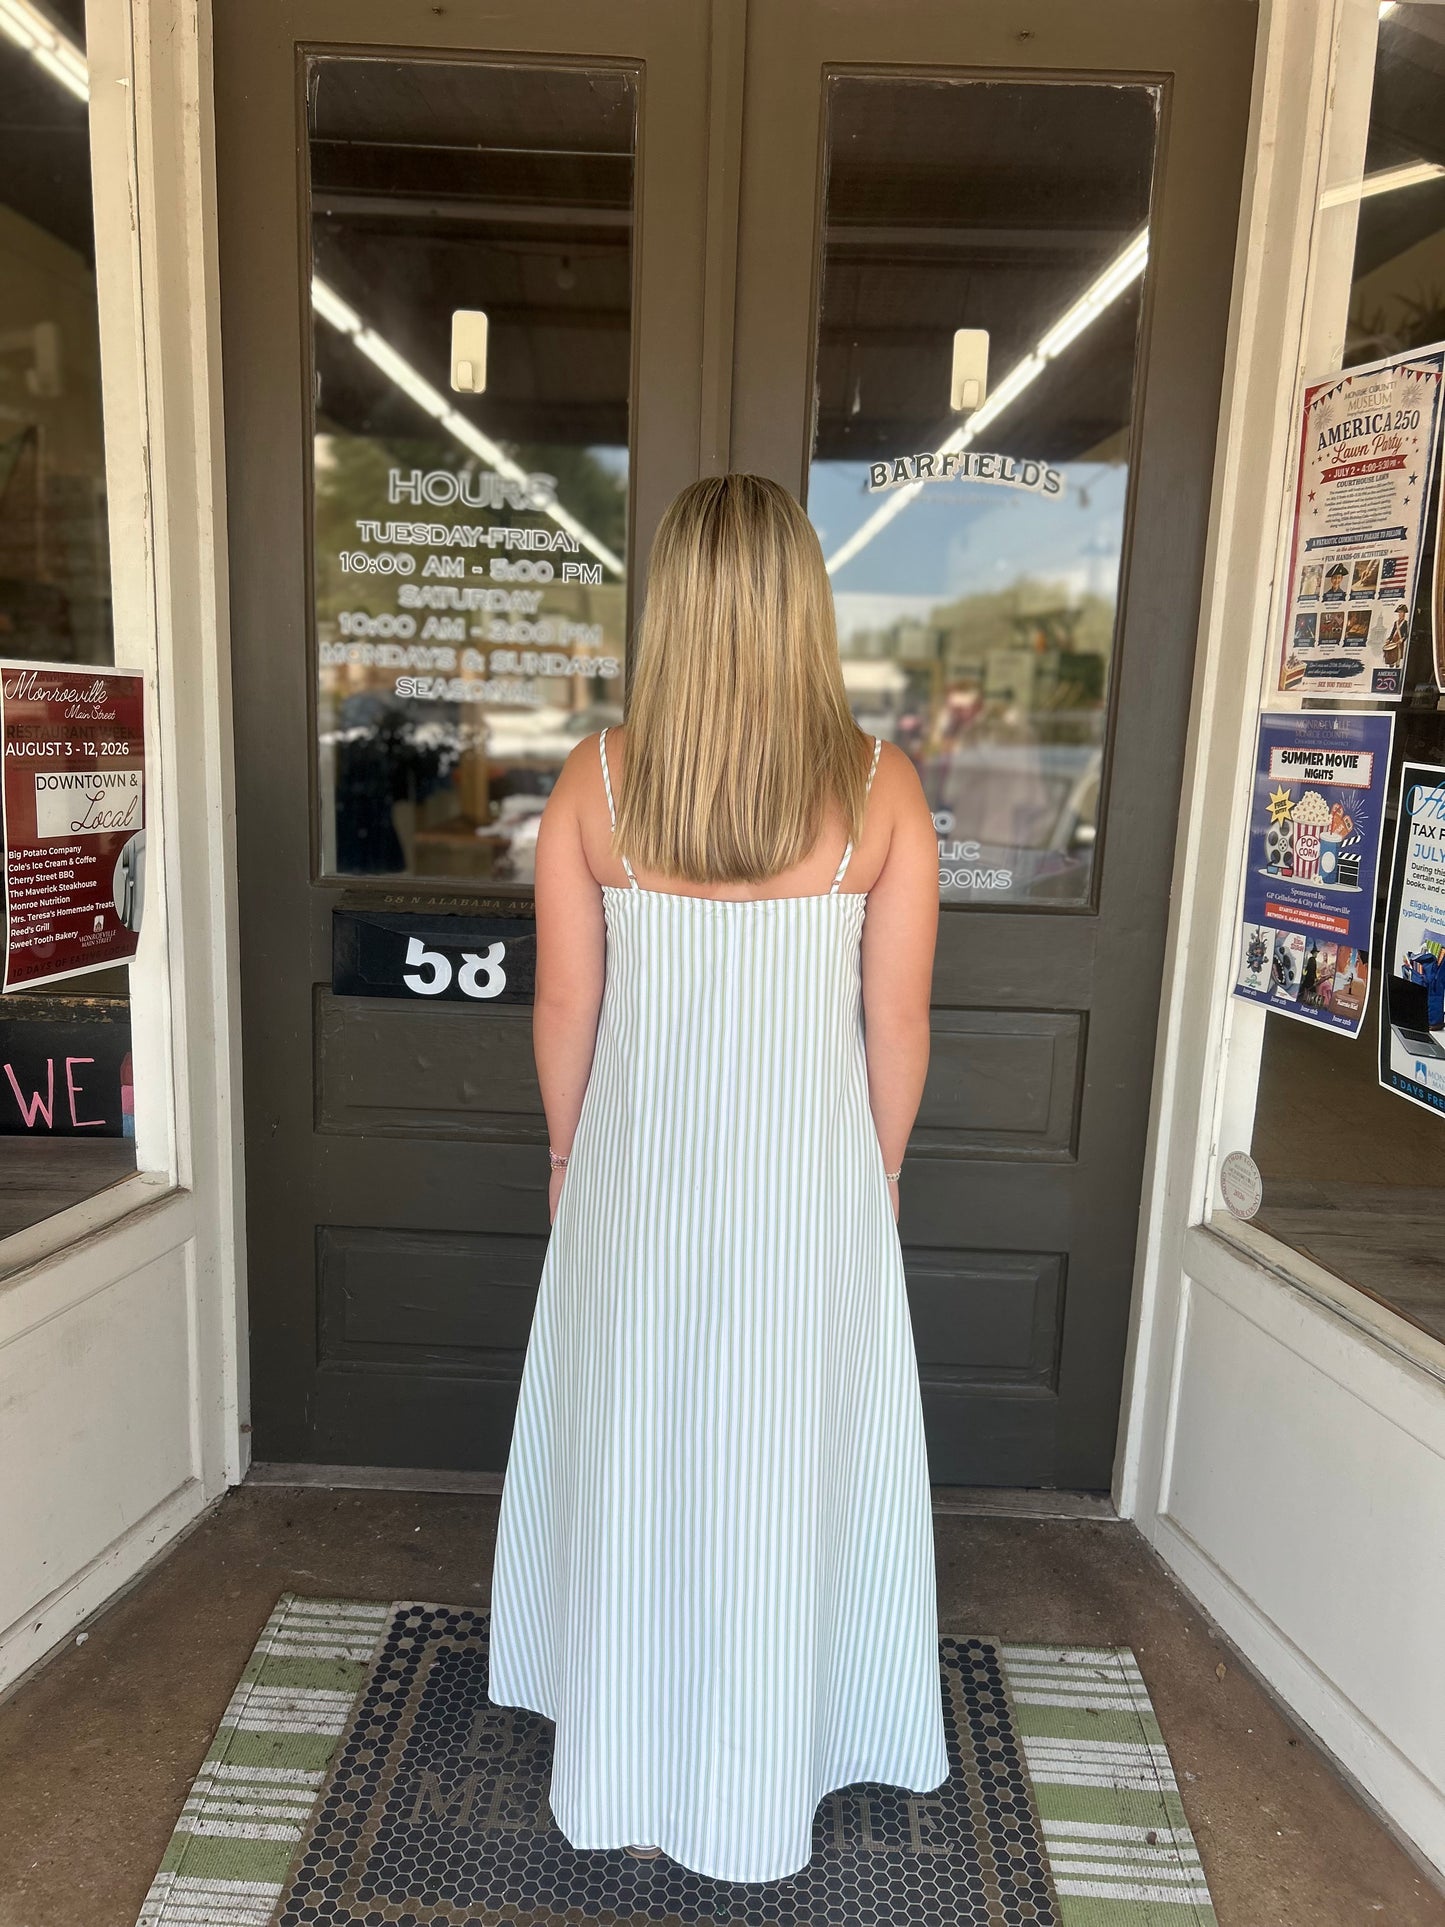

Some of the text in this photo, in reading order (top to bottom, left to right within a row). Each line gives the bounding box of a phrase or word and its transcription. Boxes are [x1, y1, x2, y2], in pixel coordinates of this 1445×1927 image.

[1347, 392, 1392, 411] MUSEUM
[1317, 412, 1392, 452] AMERICA
[1393, 409, 1420, 431] 250
[1331, 432, 1403, 464] Lawn Party
[869, 452, 1065, 497] BARFIELD'S
[1333, 466, 1350, 479] JULY
[1350, 467, 1356, 476] 2
[388, 468, 558, 511] HOURS
[356, 520, 582, 552] TUESDAY-FRIDAY
[1324, 554, 1336, 562] FUN
[1336, 552, 1360, 561] HANDS-ON
[339, 551, 416, 575] 10:00
[422, 555, 465, 578] AM
[489, 558, 554, 583] 5:00
[562, 563, 603, 585] PM
[398, 584, 544, 614] SATURDAY
[338, 612, 416, 638] 10:00
[421, 617, 466, 642] AM
[558, 623, 603, 648] PM
[319, 641, 620, 679] MONDAYS & SUNDAYS
[4, 671, 108, 704] Monroeville
[64, 704, 116, 720] Main Street
[7, 725, 96, 739] RESTAURANT
[5, 742, 62, 756] AUGUST
[64, 742, 72, 756] 3
[83, 742, 98, 758] 12,
[101, 742, 129, 756] 2026
[1281, 750, 1360, 769] SUMMER MOVIE
[36, 773, 138, 791] DOWNTOWN &
[1304, 768, 1334, 781] NIGHTS
[70, 790, 138, 832] Local
[1412, 822, 1436, 840] TAX
[1300, 837, 1318, 849] POP
[8, 845, 82, 860] Big Potato Company
[1298, 847, 1318, 859] CORN
[8, 861, 31, 872] Cole's
[32, 861, 43, 870] Ice
[44, 859, 68, 868] Cream
[75, 855, 97, 864] Coffee
[1411, 862, 1433, 876] During
[8, 869, 75, 886] Cherry Street BBQ
[1405, 878, 1427, 891] books,
[1427, 883, 1440, 894] and
[1412, 871, 1435, 884] certain
[9, 879, 98, 898] The Maverick Steakhouse
[1290, 887, 1327, 900] Sponsored by:
[10, 895, 71, 912] Monroe Nutrition
[384, 895, 403, 903] 58
[411, 896, 422, 904] N
[427, 897, 501, 909] ALABAMA
[1274, 892, 1298, 904] Cellulose
[1302, 897, 1313, 907] City
[1319, 901, 1351, 915] Monroeville
[1409, 899, 1434, 914] Eligible
[10, 900, 115, 924] Mrs. Teresa's Homemade Treats
[1402, 909, 1430, 924] typically
[10, 922, 50, 937] Reed's Grill
[10, 930, 79, 950] Sweet Tooth Bakery
[402, 936, 507, 999] 58
[3, 1057, 106, 1129] WE
[1392, 1075, 1398, 1085] 3
[1400, 1079, 1425, 1099] DAYS
[1427, 1092, 1445, 1109] FRE
